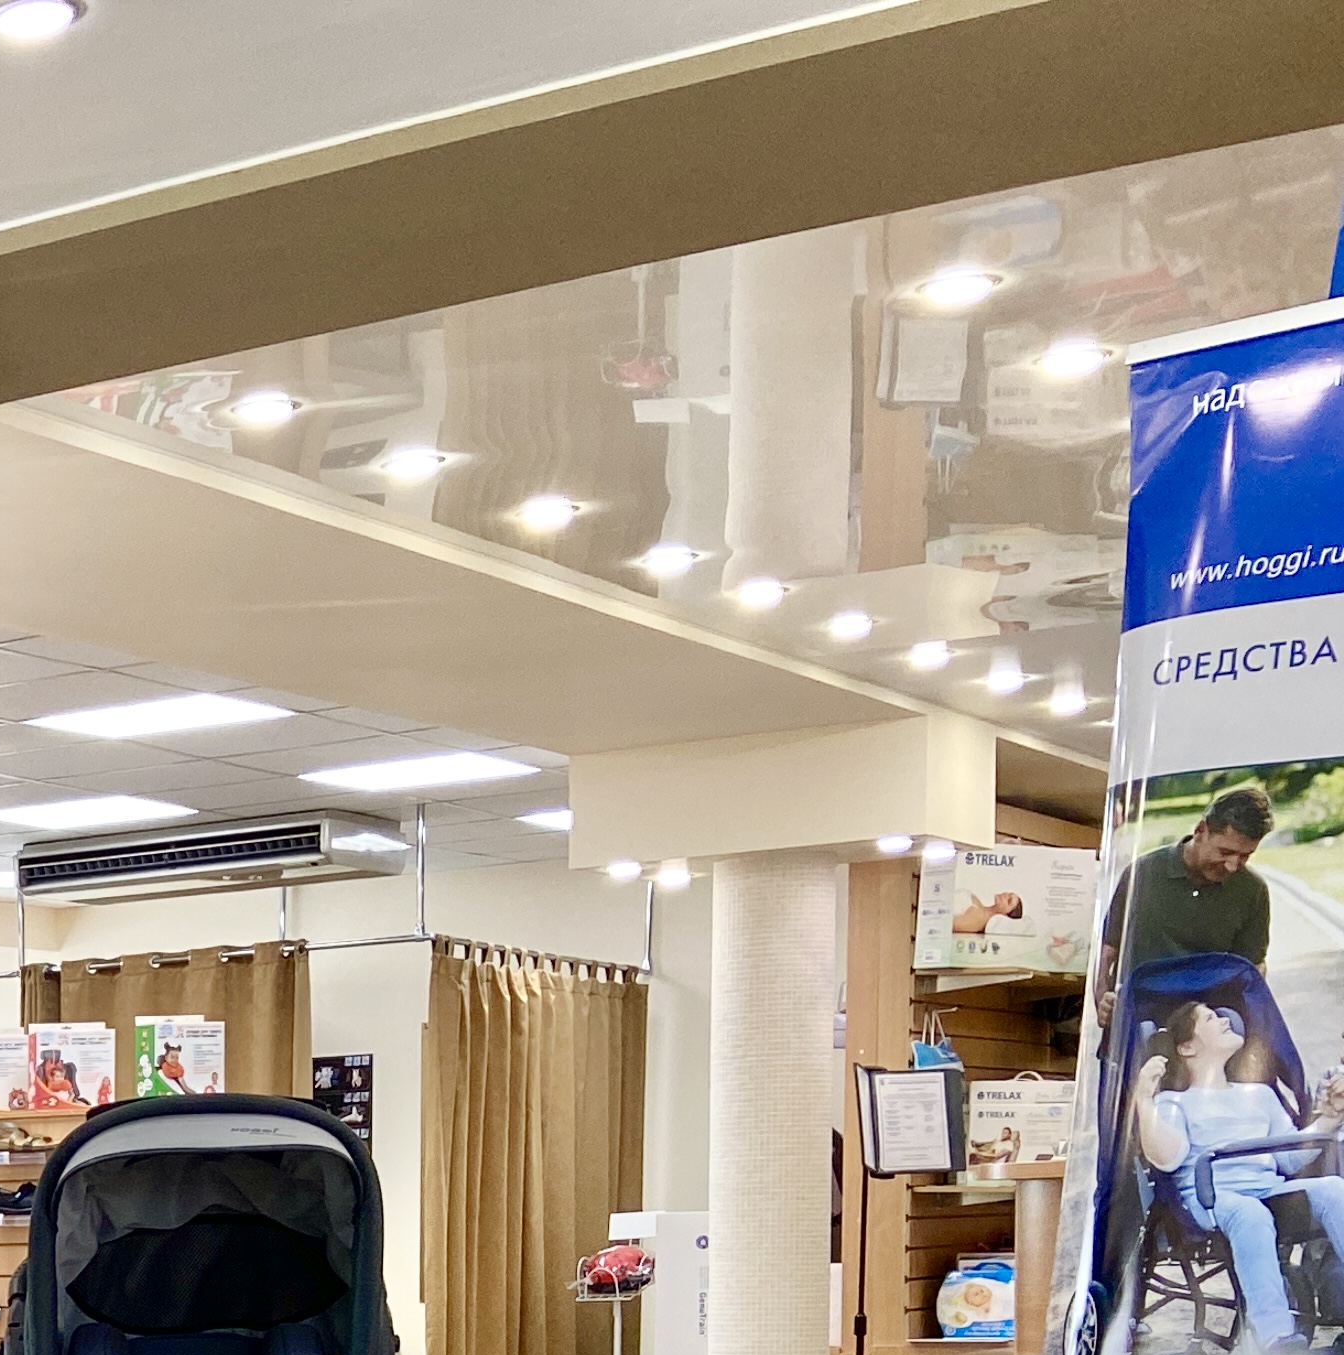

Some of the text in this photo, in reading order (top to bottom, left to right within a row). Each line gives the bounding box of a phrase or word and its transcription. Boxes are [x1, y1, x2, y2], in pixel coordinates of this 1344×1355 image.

[1153, 636, 1338, 686] СРЕДСТВА
[975, 853, 1015, 867] TRELAX
[986, 1092, 1022, 1100] TRELAX
